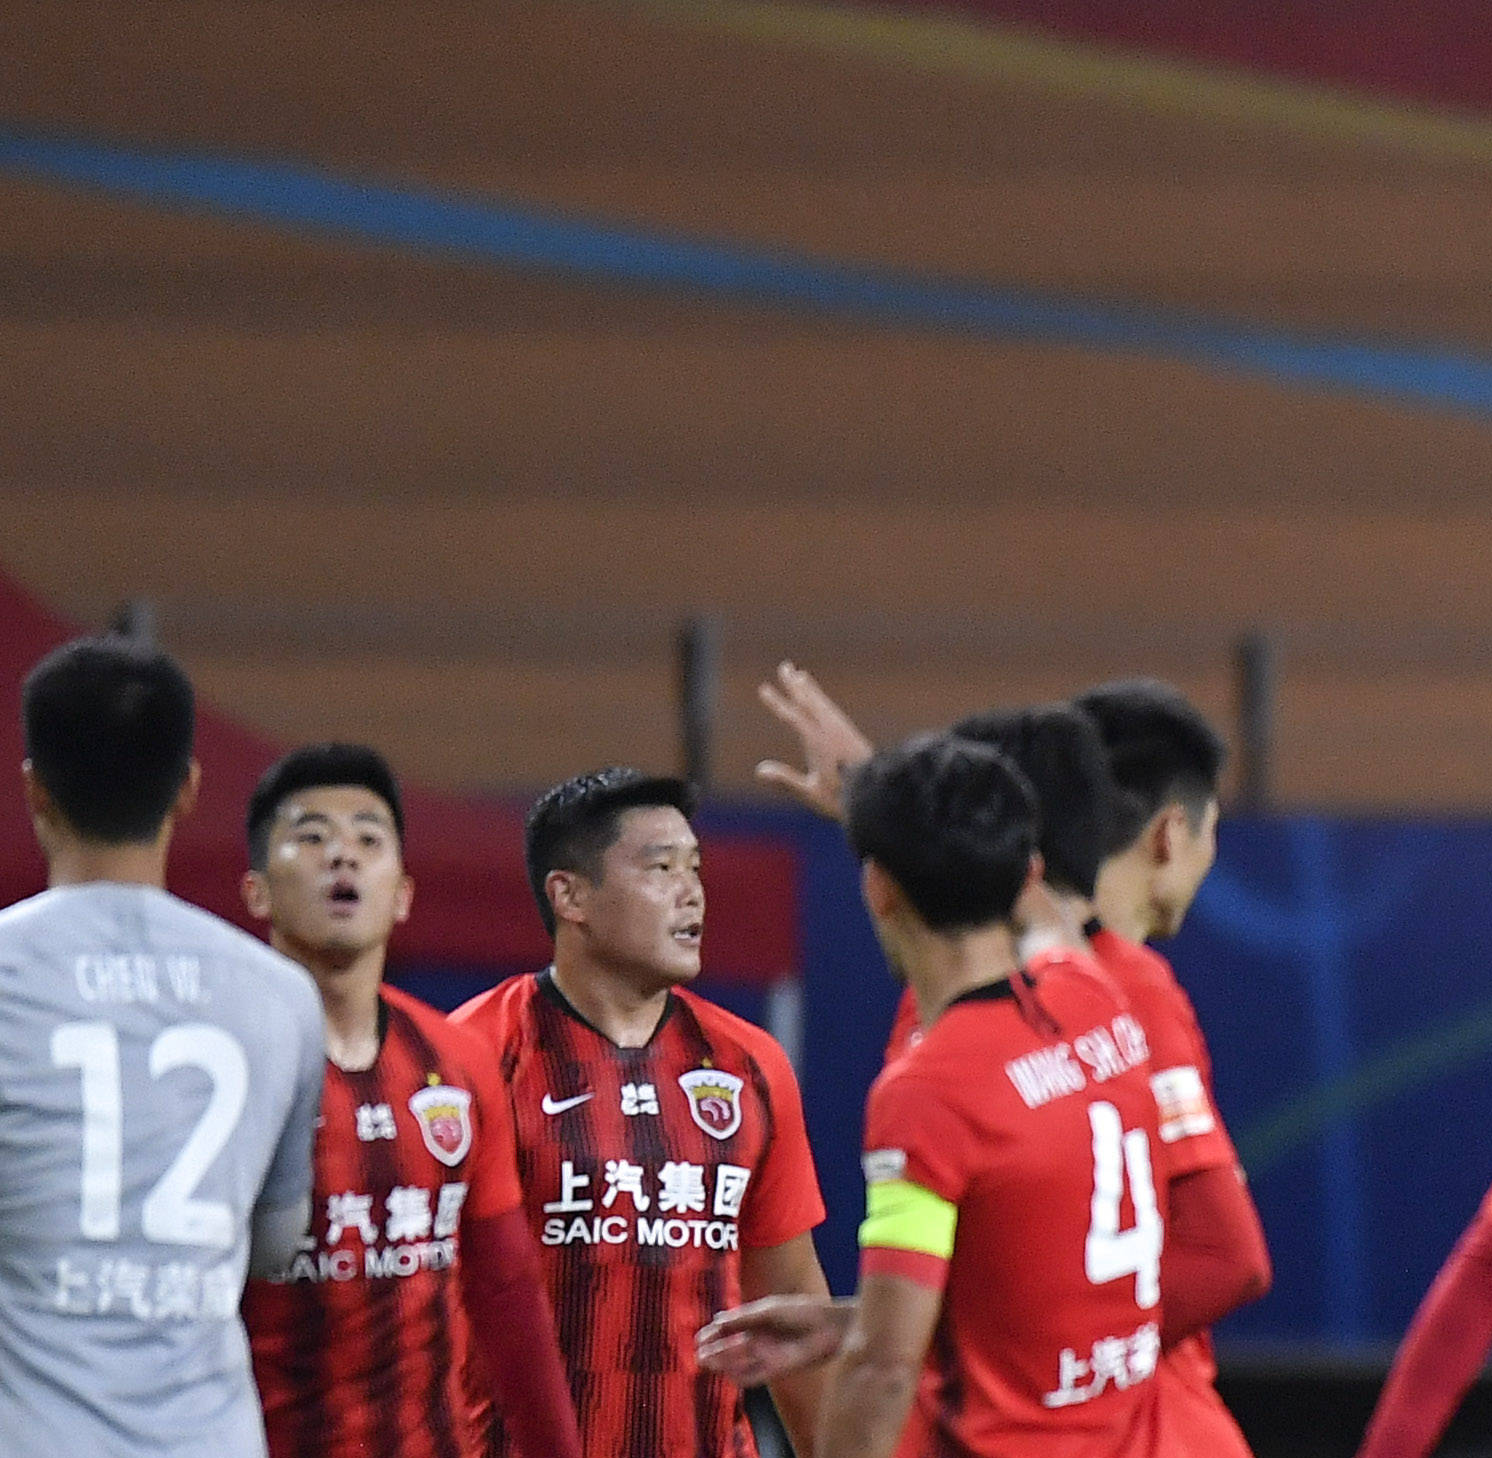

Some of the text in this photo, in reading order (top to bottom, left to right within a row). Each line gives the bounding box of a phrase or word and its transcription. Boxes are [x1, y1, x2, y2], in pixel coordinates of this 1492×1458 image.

[50, 1019, 249, 1250] 12
[300, 1181, 470, 1246] 汽集团
[543, 1160, 752, 1218] 上汽集团
[1086, 1100, 1164, 1309] 4
[541, 1217, 739, 1252] SAIC MOTOR
[268, 1249, 358, 1283] AIC
